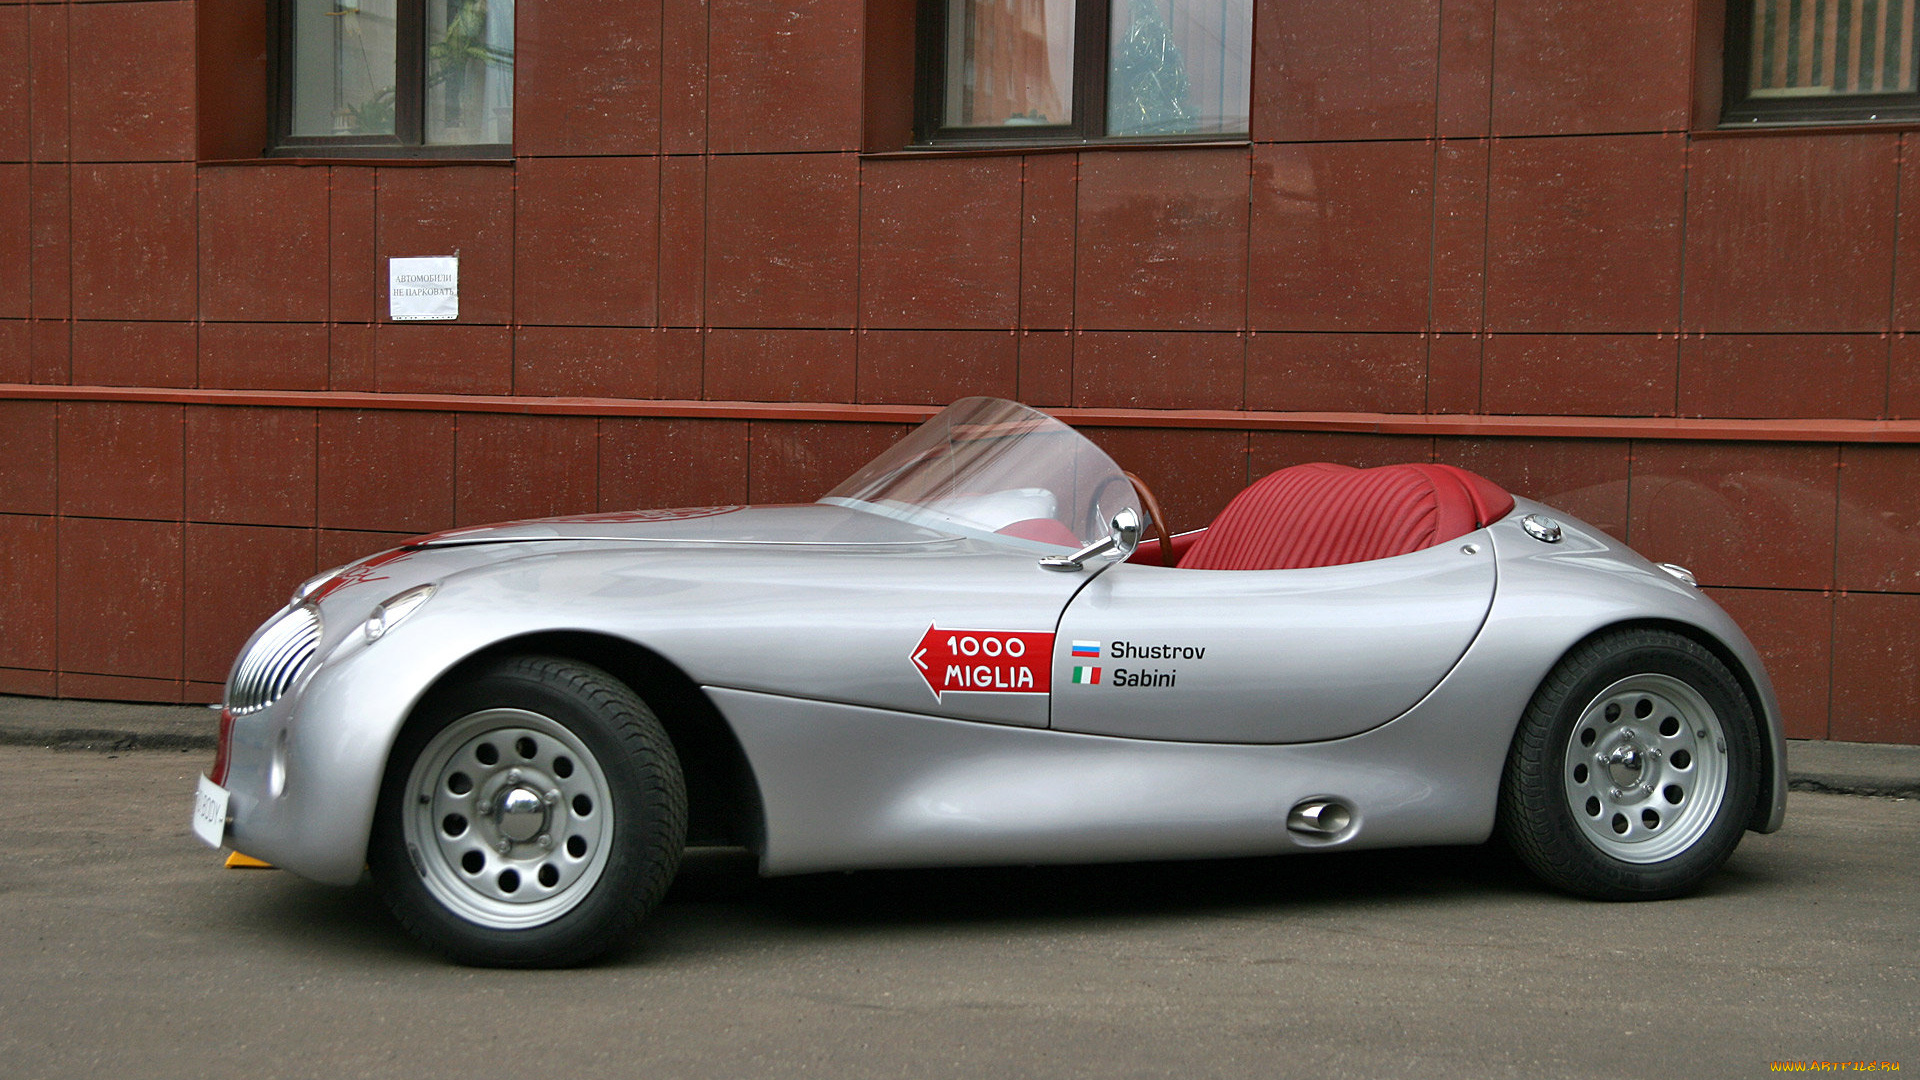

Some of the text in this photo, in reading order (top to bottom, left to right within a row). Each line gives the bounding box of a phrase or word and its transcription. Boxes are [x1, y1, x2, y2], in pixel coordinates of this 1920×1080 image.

[395, 274, 452, 283] АВТОМОБИЛИ
[393, 287, 454, 297] НЕ ПАРКОВАТЬ
[946, 635, 1026, 658] 1000
[1110, 641, 1206, 660] Shustrov
[944, 664, 1034, 688] MIGLIA
[1112, 668, 1176, 688] Sabini
